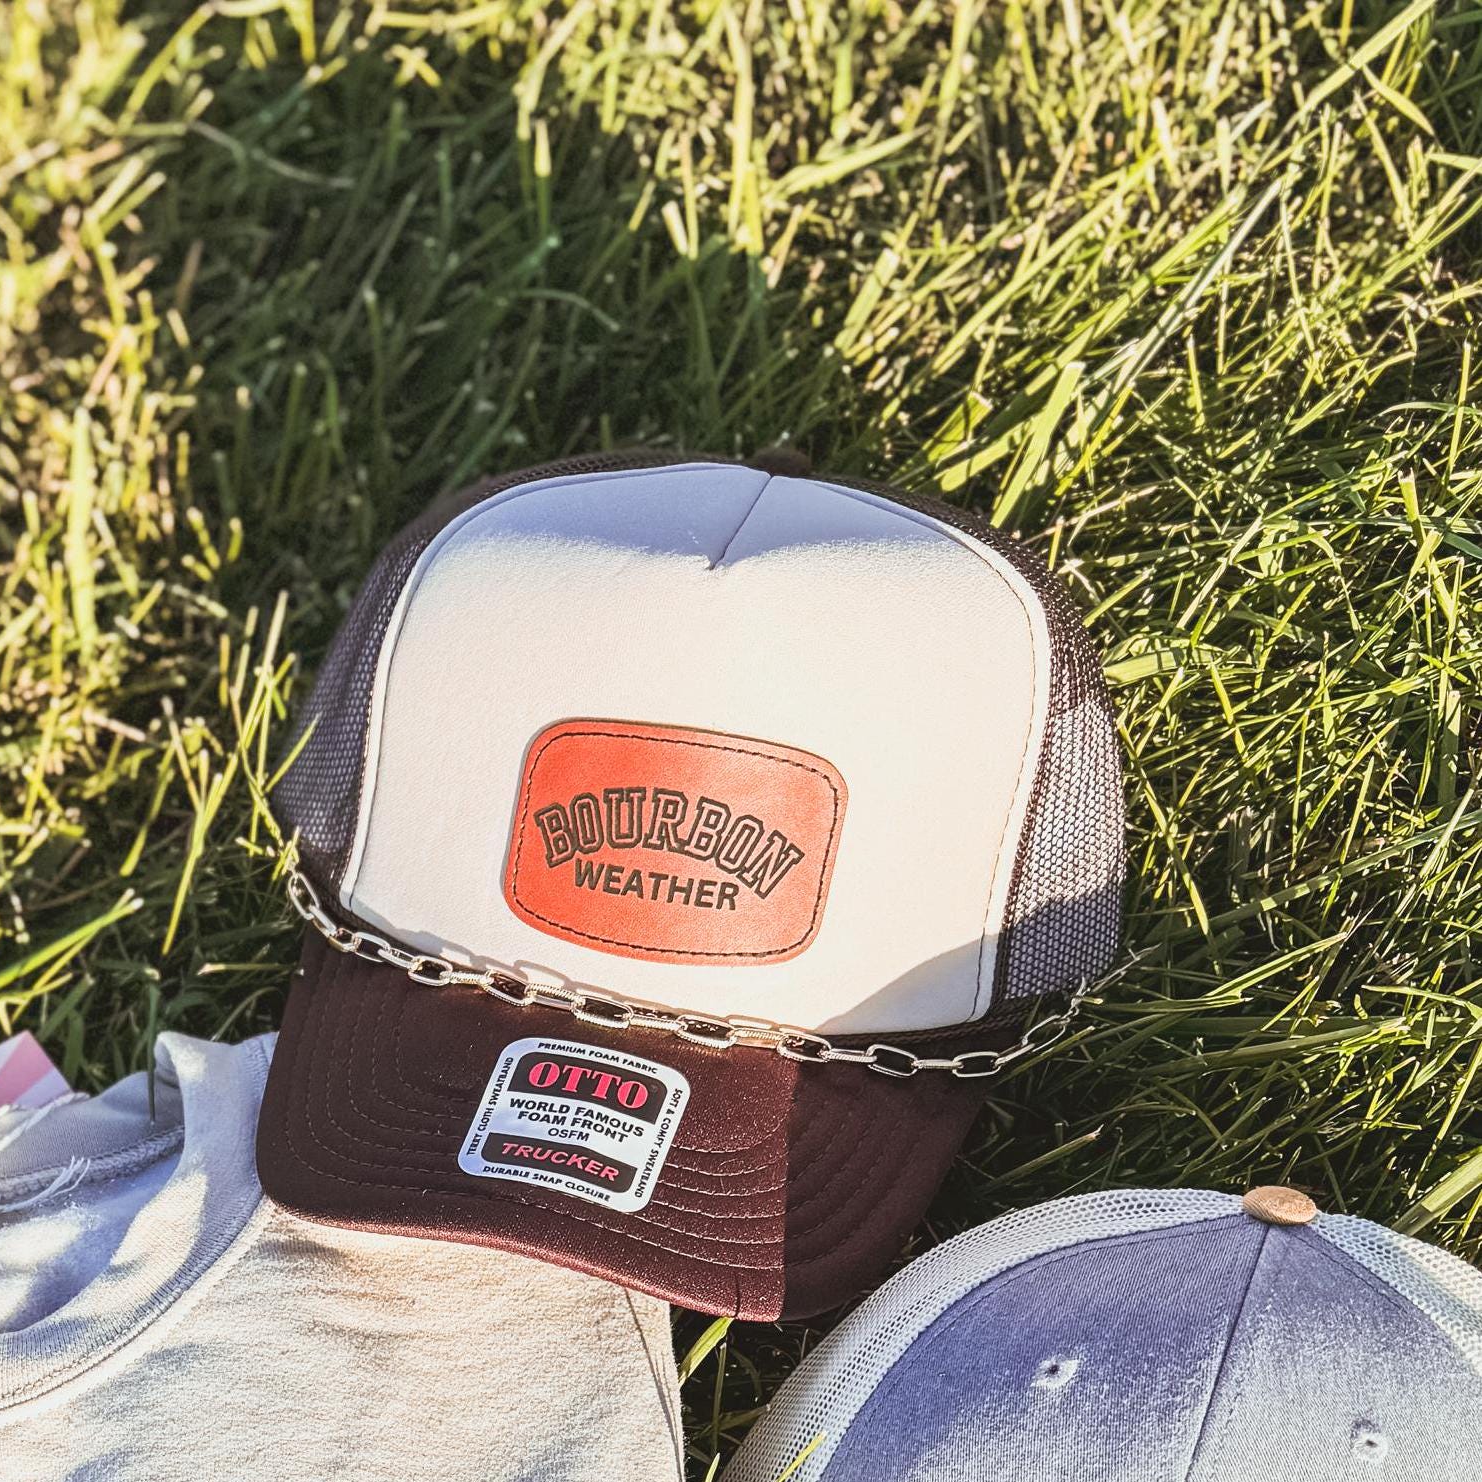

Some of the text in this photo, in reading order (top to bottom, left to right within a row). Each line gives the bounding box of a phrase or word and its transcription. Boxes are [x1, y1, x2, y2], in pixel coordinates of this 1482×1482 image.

[533, 787, 805, 900] BOURBON
[574, 858, 740, 910] WEATHER
[538, 1042, 658, 1074] PREMIUM FOAM FABRIC
[528, 1061, 649, 1109] OTTO
[670, 1088, 683, 1108] SOFT
[467, 1057, 514, 1155] TERRY CLOTH SWEATBAND
[509, 1098, 645, 1137] WORLD FAMOUS
[518, 1110, 628, 1143] FOAM FRONT
[548, 1127, 590, 1142] OSFM
[654, 1117, 671, 1148] COMFY
[501, 1142, 619, 1182] TRUCKER
[634, 1149, 659, 1198] SWEATBAND
[483, 1165, 611, 1202] DURABLE SNAP CLOSURE
